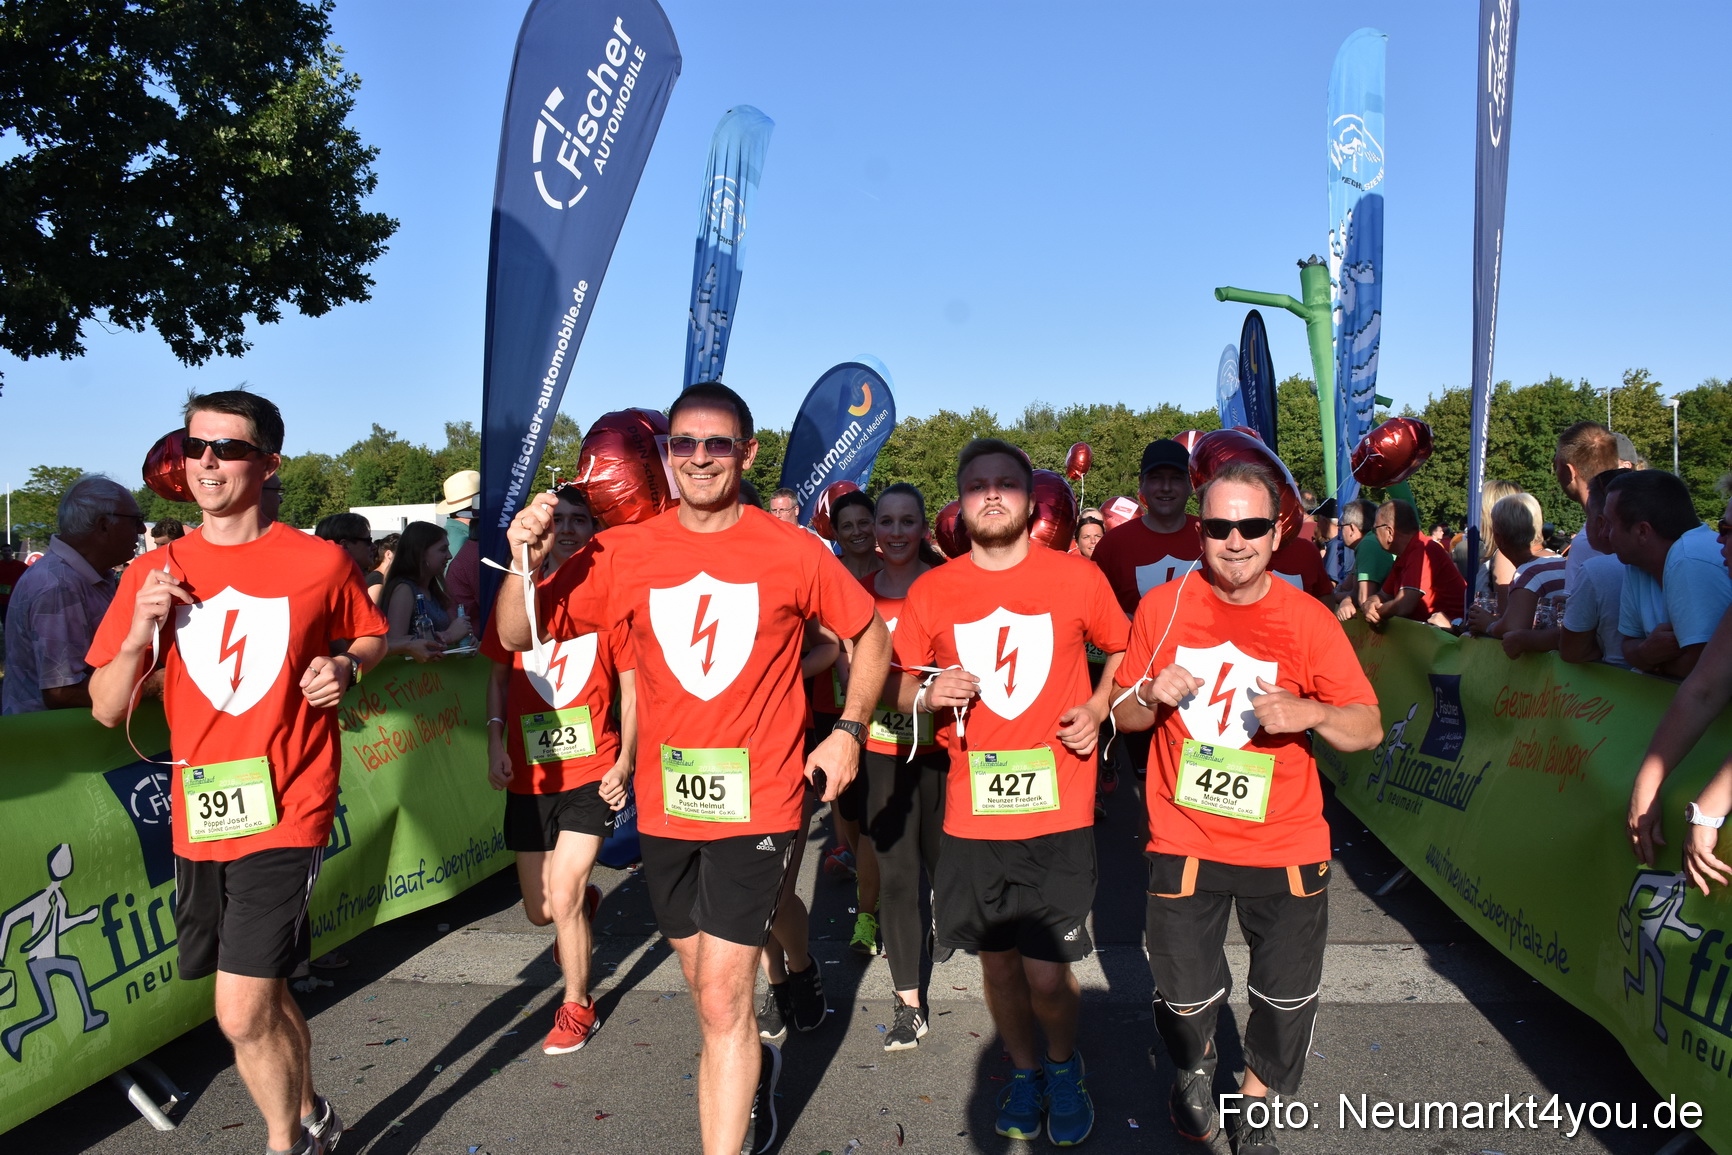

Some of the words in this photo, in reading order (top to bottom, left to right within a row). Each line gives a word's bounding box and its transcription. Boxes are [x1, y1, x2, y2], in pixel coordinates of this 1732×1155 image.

[557, 16, 632, 180] Fischer
[593, 45, 647, 176] AUTOMOBILE
[497, 279, 589, 529] www.fischer-automobile.de
[627, 425, 649, 459] DEHN
[798, 421, 863, 507] rischmann
[838, 449, 858, 471] Druck
[856, 432, 870, 450] und
[868, 409, 889, 435] Medien
[338, 685, 387, 731] unde
[384, 671, 445, 708] Firmen
[881, 711, 914, 731] 424
[1494, 677, 1551, 719] Gesunde
[1551, 682, 1615, 725] Firmen
[353, 725, 419, 773] laufen
[413, 692, 468, 746] länger!
[538, 726, 577, 748] 423
[988, 772, 1036, 796] 427
[1195, 768, 1250, 799] 426
[1394, 743, 1492, 812] firmenlauf
[1507, 728, 1543, 771] laufen
[1543, 736, 1607, 793] länger!
[198, 787, 245, 820] 391
[675, 774, 726, 802] 405
[679, 799, 698, 808] Pusch
[699, 802, 725, 810] Helmut
[1015, 795, 1043, 803] Frederik
[1222, 797, 1237, 806] Olaf
[1387, 792, 1424, 815] neumarkt
[203, 817, 225, 828] Pöppel
[227, 815, 249, 825] Josef
[311, 826, 508, 940] ww.firmenlauf-oberpfalz.de
[101, 892, 178, 974] fir
[125, 954, 180, 1005] neu
